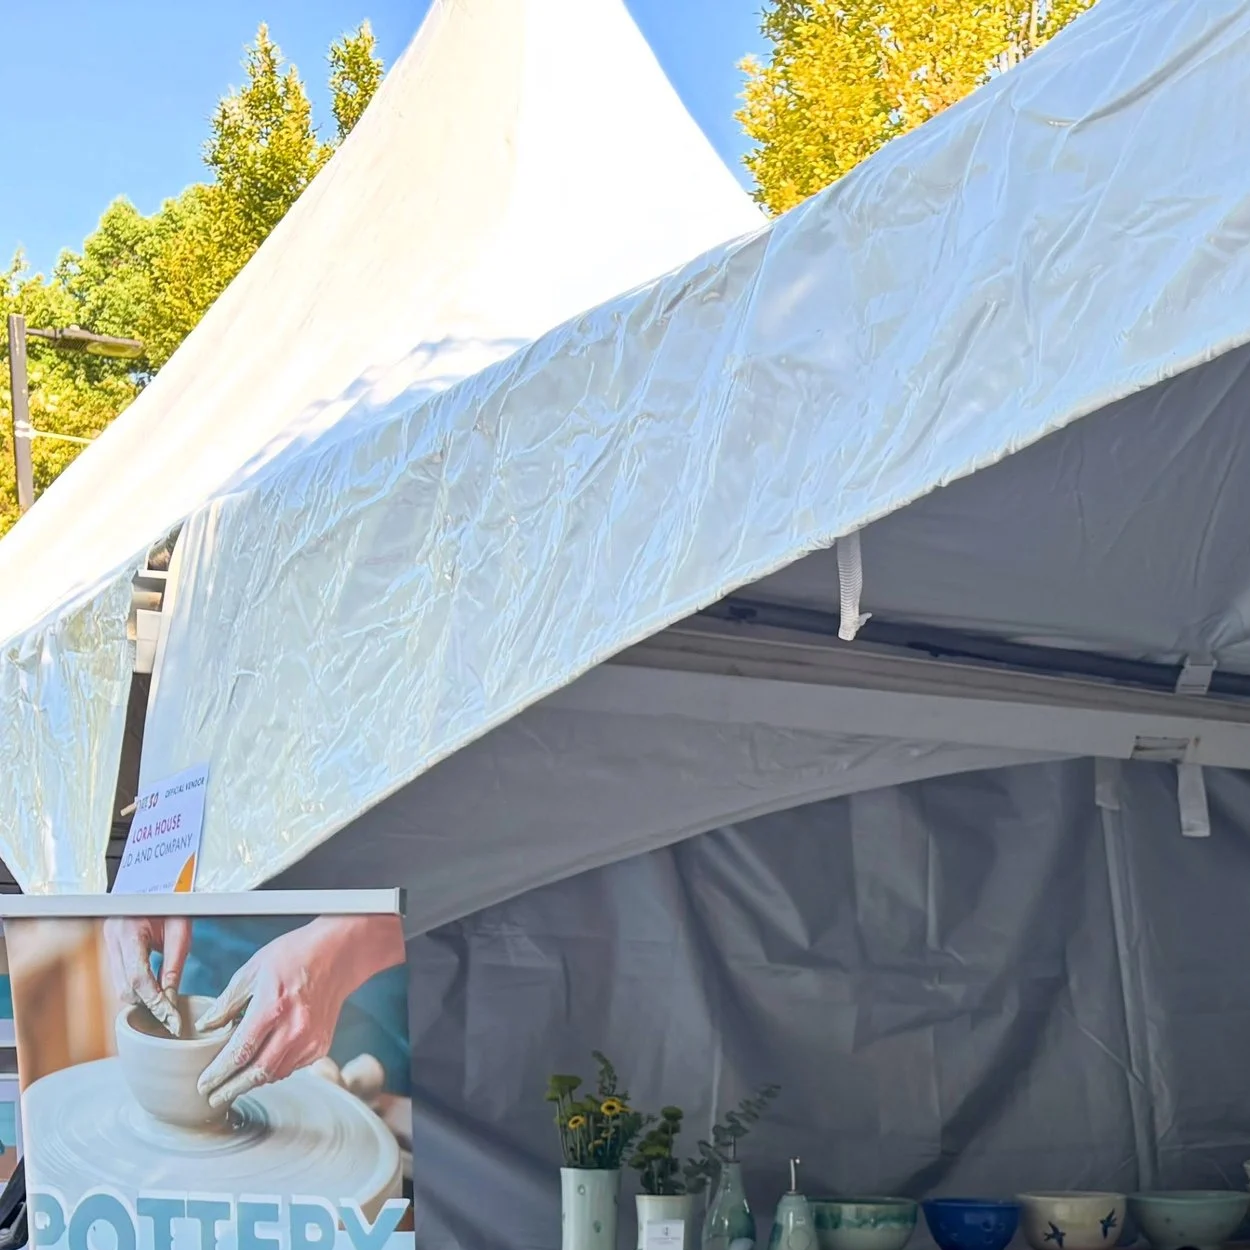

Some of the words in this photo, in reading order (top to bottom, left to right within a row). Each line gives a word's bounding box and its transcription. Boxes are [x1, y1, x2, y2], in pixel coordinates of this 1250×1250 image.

[185, 776, 205, 790] VENDOR
[132, 824, 153, 844] LORA
[155, 813, 181, 835] HOUSE
[134, 847, 152, 865] AND
[154, 833, 193, 859] COMPANY
